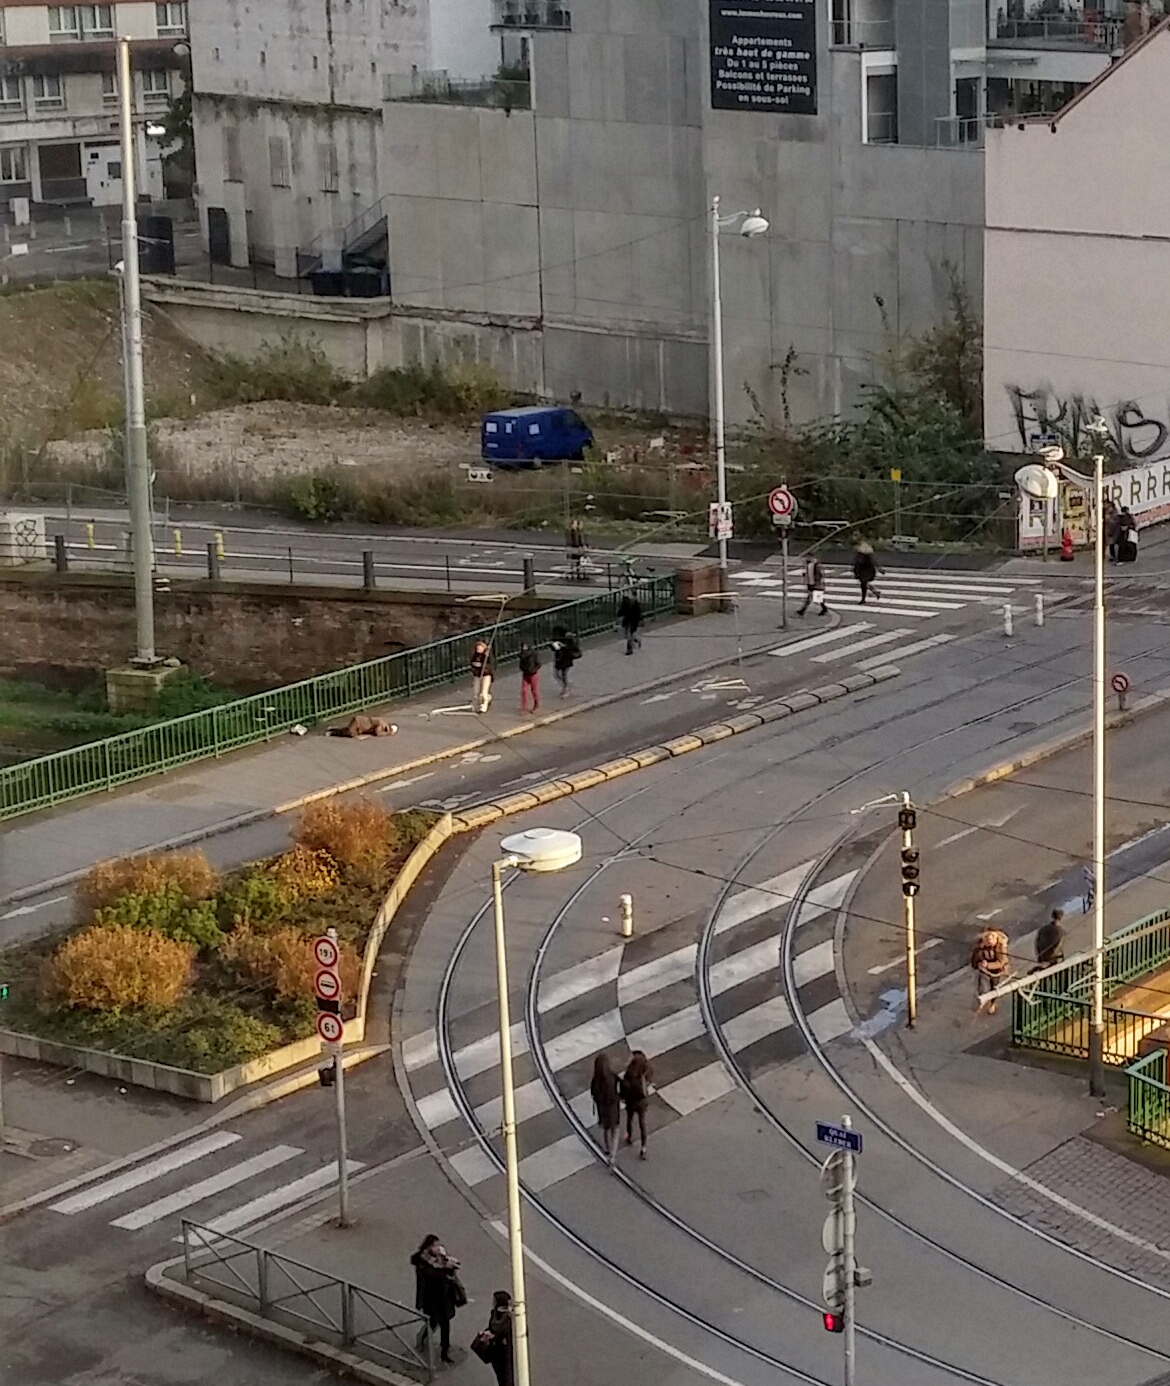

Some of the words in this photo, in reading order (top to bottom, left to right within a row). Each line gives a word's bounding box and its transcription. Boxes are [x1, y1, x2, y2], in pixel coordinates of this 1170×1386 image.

[732, 35, 793, 47] Appartements
[714, 46, 734, 56] très
[736, 47, 759, 57] haut
[761, 48, 773, 58] de
[776, 51, 811, 60] gamme
[741, 59, 746, 68] 1
[748, 60, 760, 69] au
[769, 61, 799, 71] pièces
[718, 69, 753, 79] Balcons
[755, 72, 765, 81] et
[766, 73, 808, 83] terrasses
[716, 80, 761, 91] Possibilité
[763, 83, 774, 93] de
[777, 83, 811, 96] Parking
[751, 95, 789, 105] sous-sol
